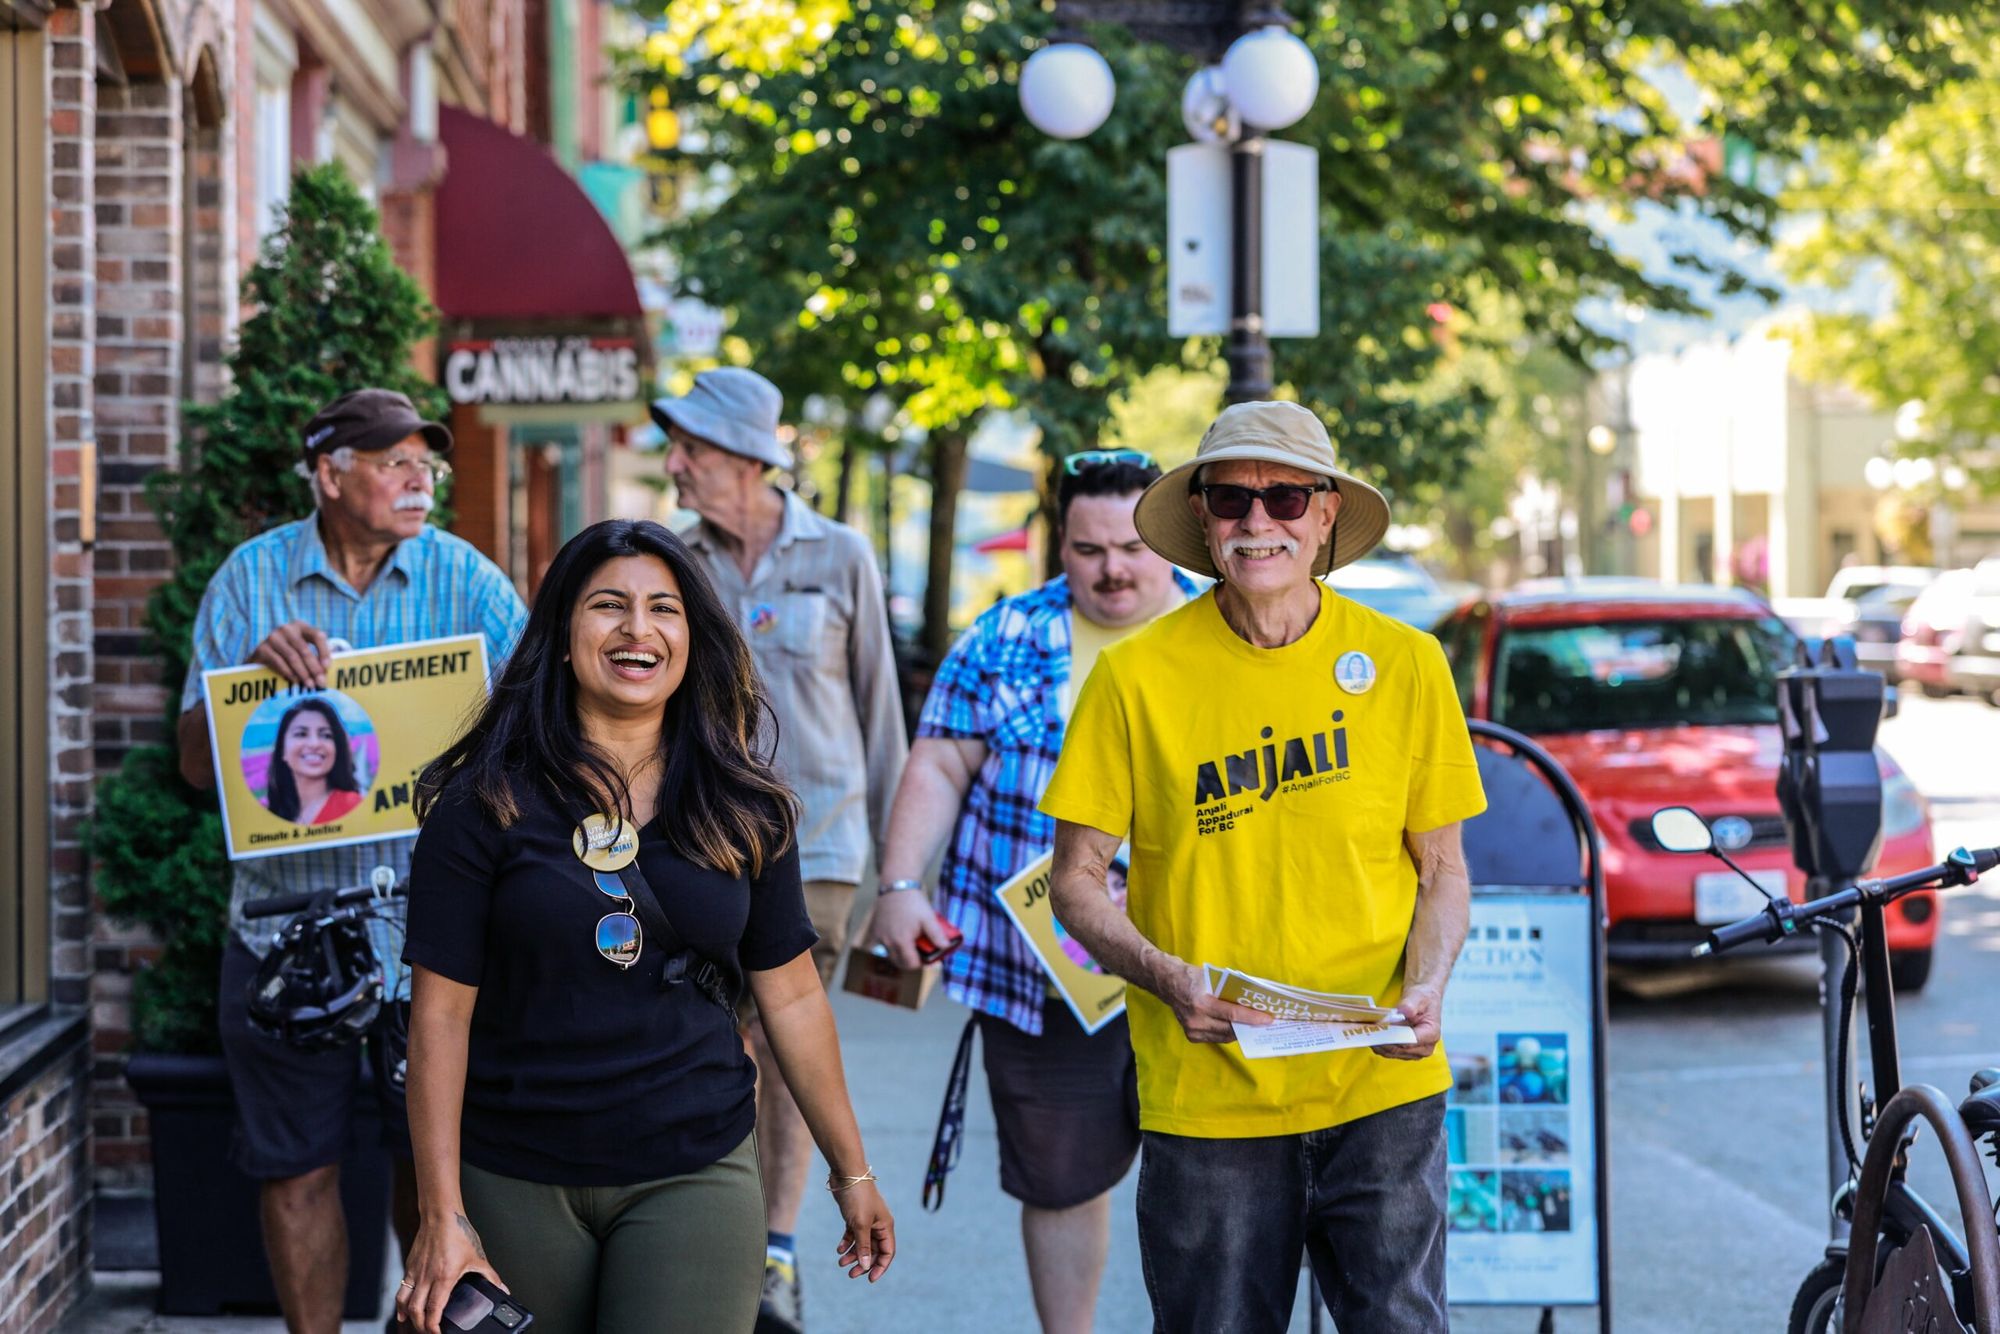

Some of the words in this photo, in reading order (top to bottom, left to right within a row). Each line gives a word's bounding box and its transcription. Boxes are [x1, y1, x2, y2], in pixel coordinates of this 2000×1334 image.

[446, 349, 640, 404] CANNABIS
[225, 677, 277, 706] JOIN
[337, 651, 472, 690] MOVEMENT
[1281, 770, 1351, 794] #AnjaliForBC
[1195, 802, 1227, 818] Anjali
[1197, 804, 1254, 828] Appadurai
[249, 831, 288, 844] Climate
[292, 829, 301, 839] &
[304, 824, 343, 838] Justice
[1198, 826, 1216, 836] For
[1219, 821, 1235, 832] BC
[1023, 872, 1051, 909] JOI
[1236, 997, 1345, 1020] COURAGE
[1241, 987, 1310, 1012] TRUTH
